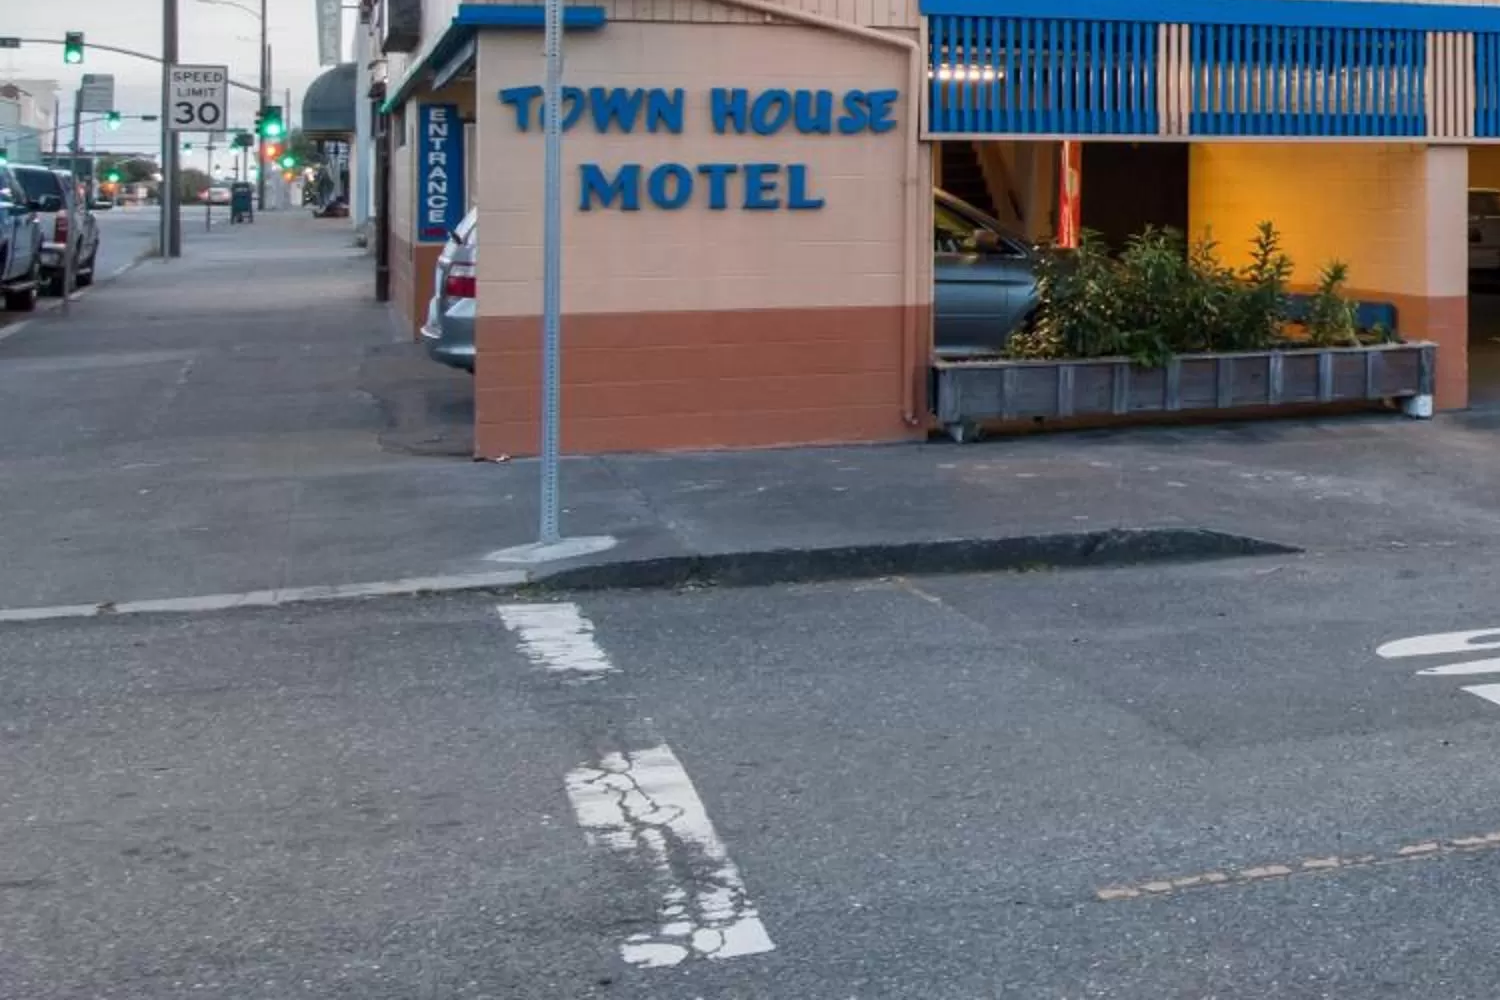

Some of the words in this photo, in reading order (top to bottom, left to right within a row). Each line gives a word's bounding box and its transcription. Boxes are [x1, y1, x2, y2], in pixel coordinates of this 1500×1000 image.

[173, 72, 222, 83] SPEED
[177, 87, 217, 97] LIMIT
[175, 101, 220, 125] 30
[499, 85, 685, 135] TOWN
[710, 87, 900, 136] HOUSE
[427, 107, 449, 223] ENTRANCE
[578, 162, 825, 213] MOTEL
